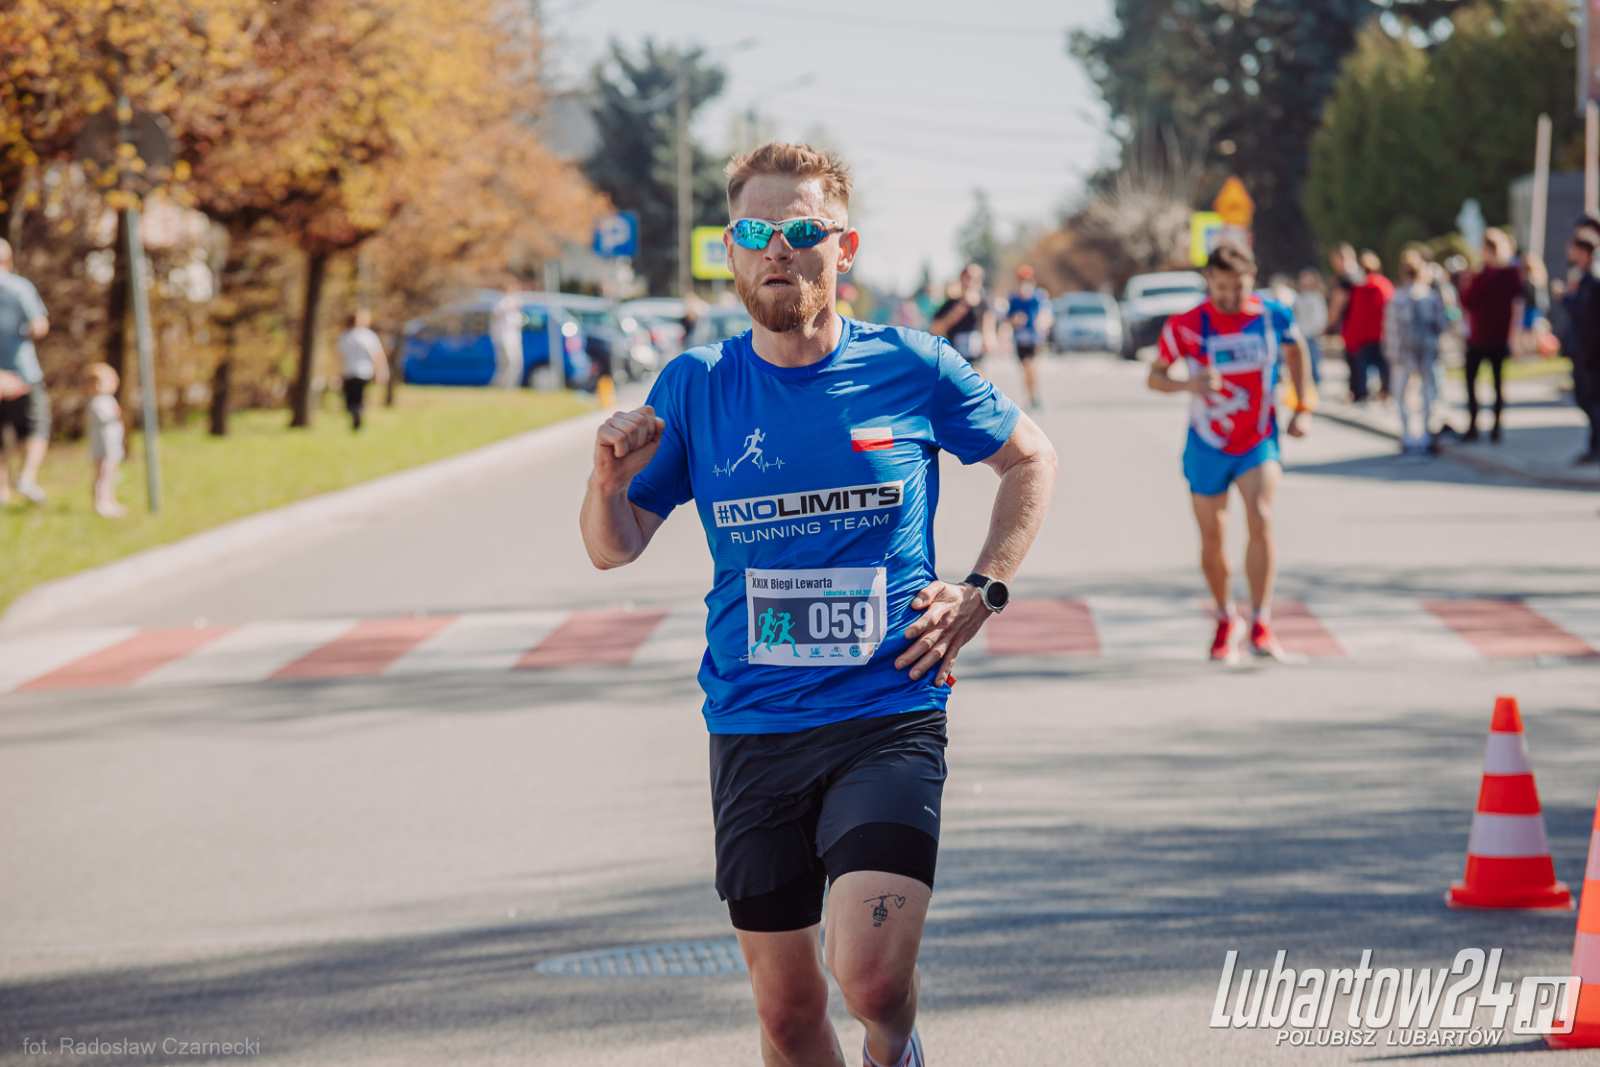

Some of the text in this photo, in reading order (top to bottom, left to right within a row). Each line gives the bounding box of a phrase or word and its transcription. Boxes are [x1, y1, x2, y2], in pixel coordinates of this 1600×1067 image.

[730, 513, 890, 544] RUNNING TEAM
[752, 577, 833, 590] XXIX Biegi Lewarta
[808, 602, 874, 640] 059
